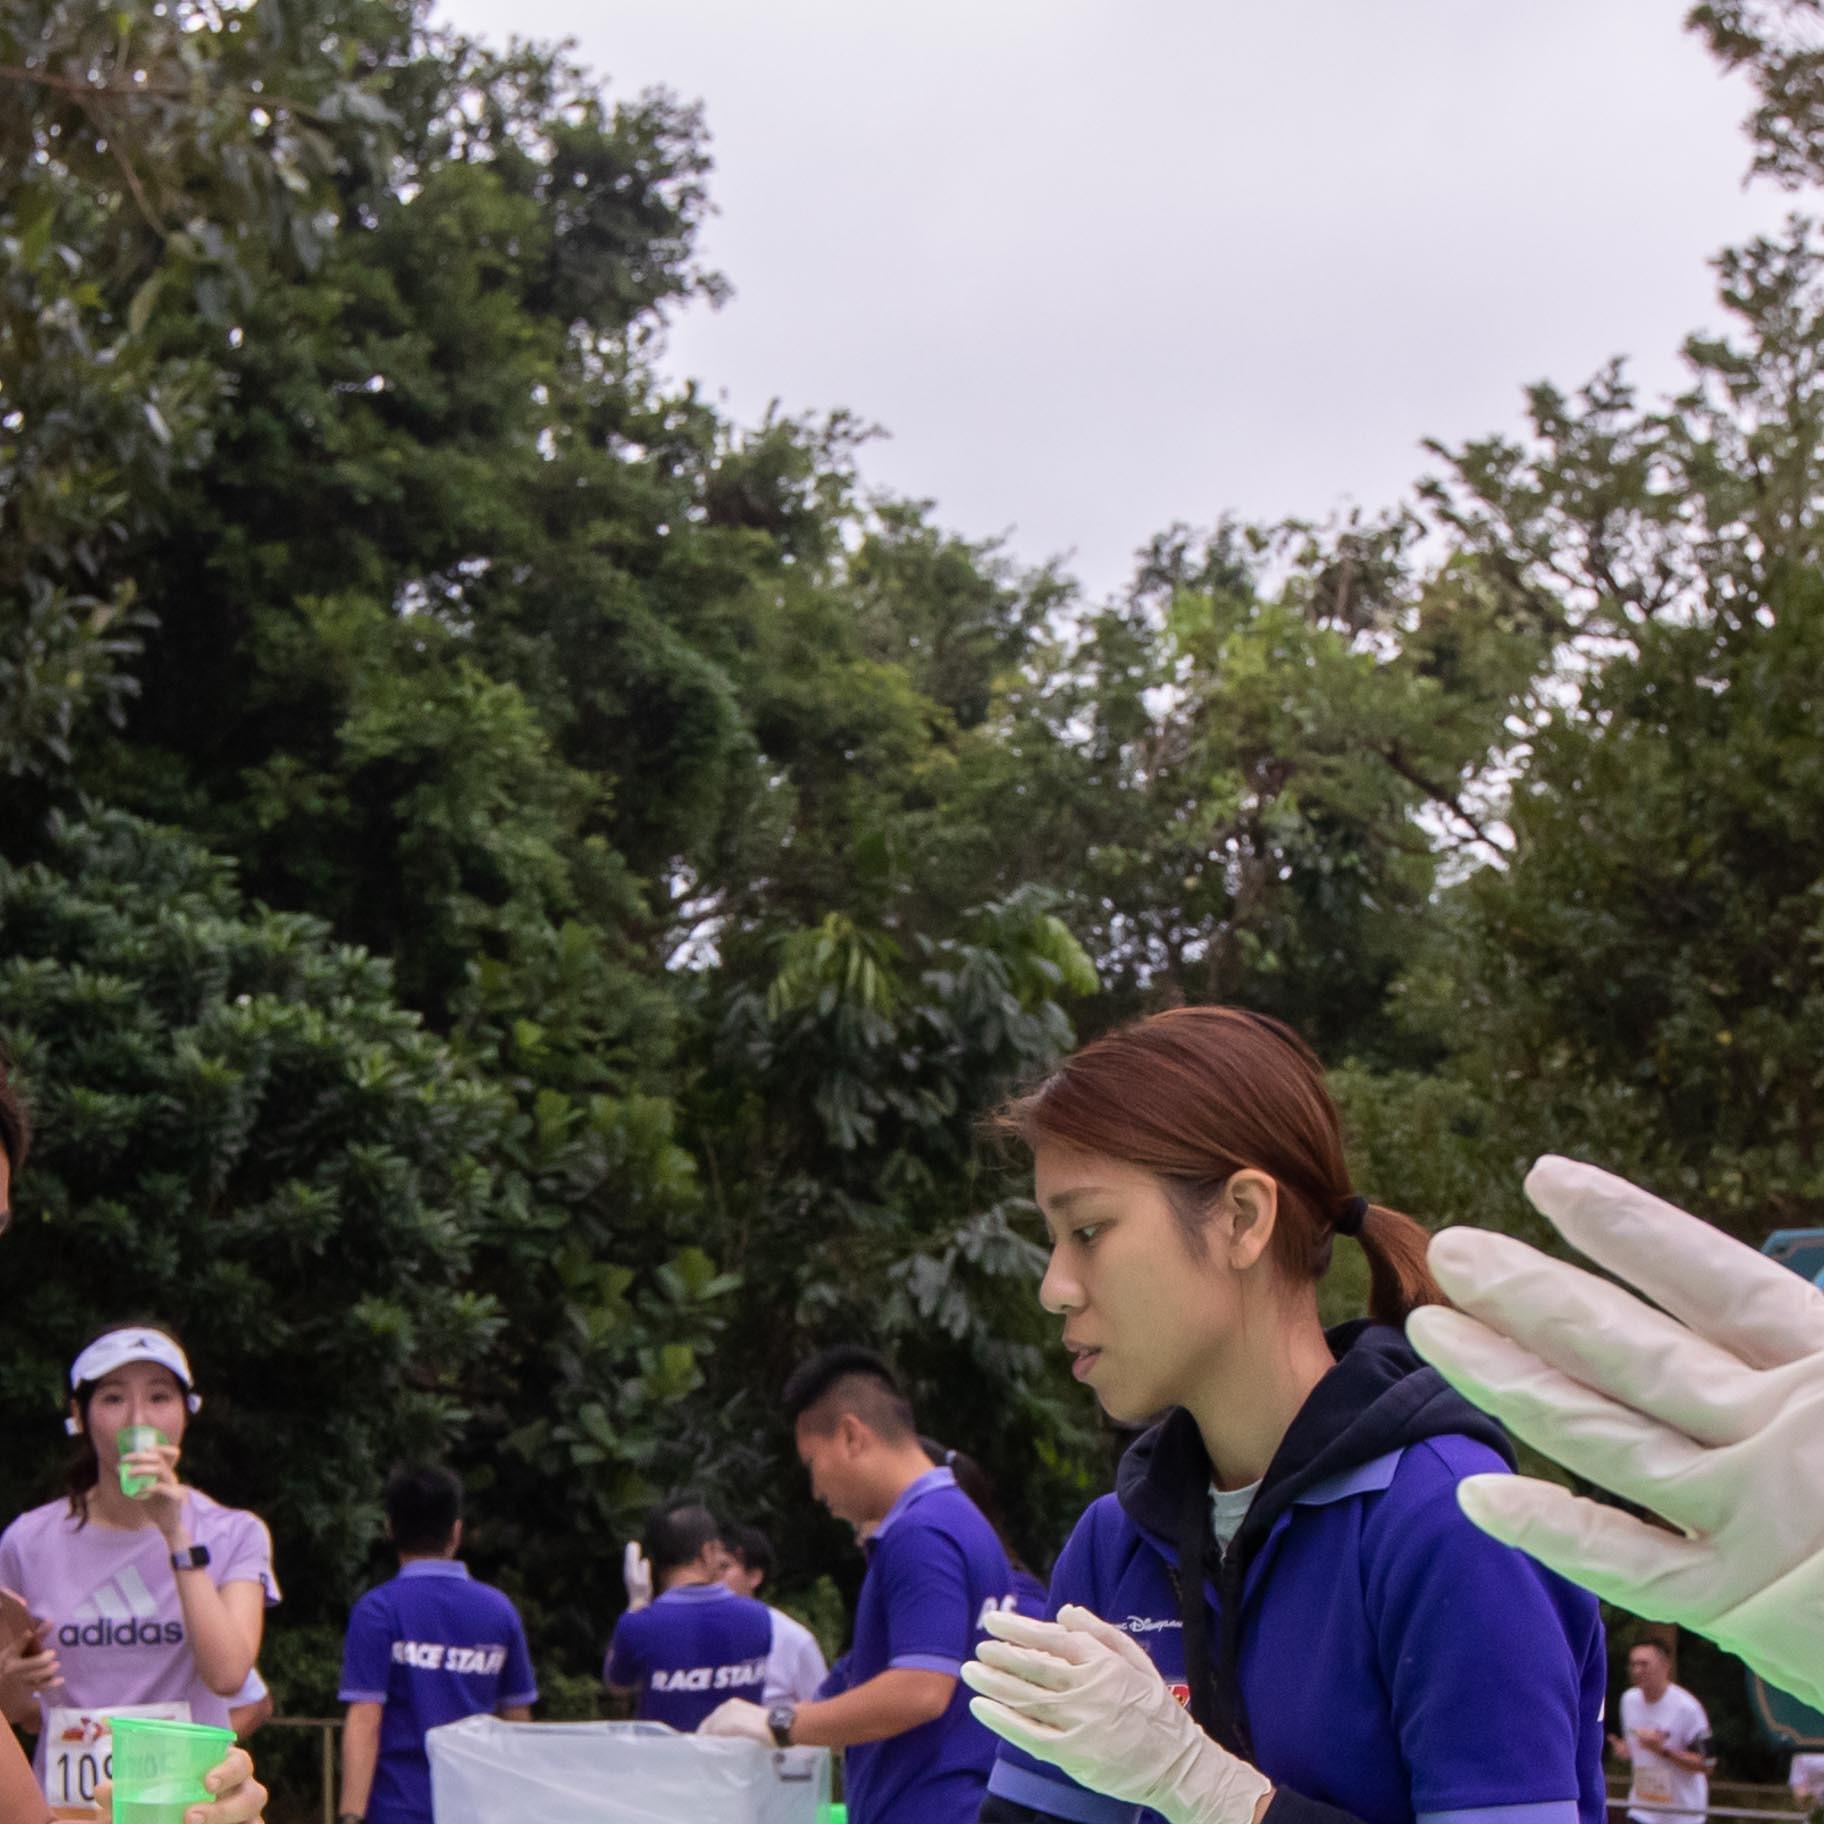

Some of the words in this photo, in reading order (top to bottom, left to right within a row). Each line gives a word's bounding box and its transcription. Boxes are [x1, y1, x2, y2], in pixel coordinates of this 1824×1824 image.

[58, 1617, 183, 1647] adidas
[392, 1640, 445, 1670] RACE
[651, 1668, 713, 1692] RACE
